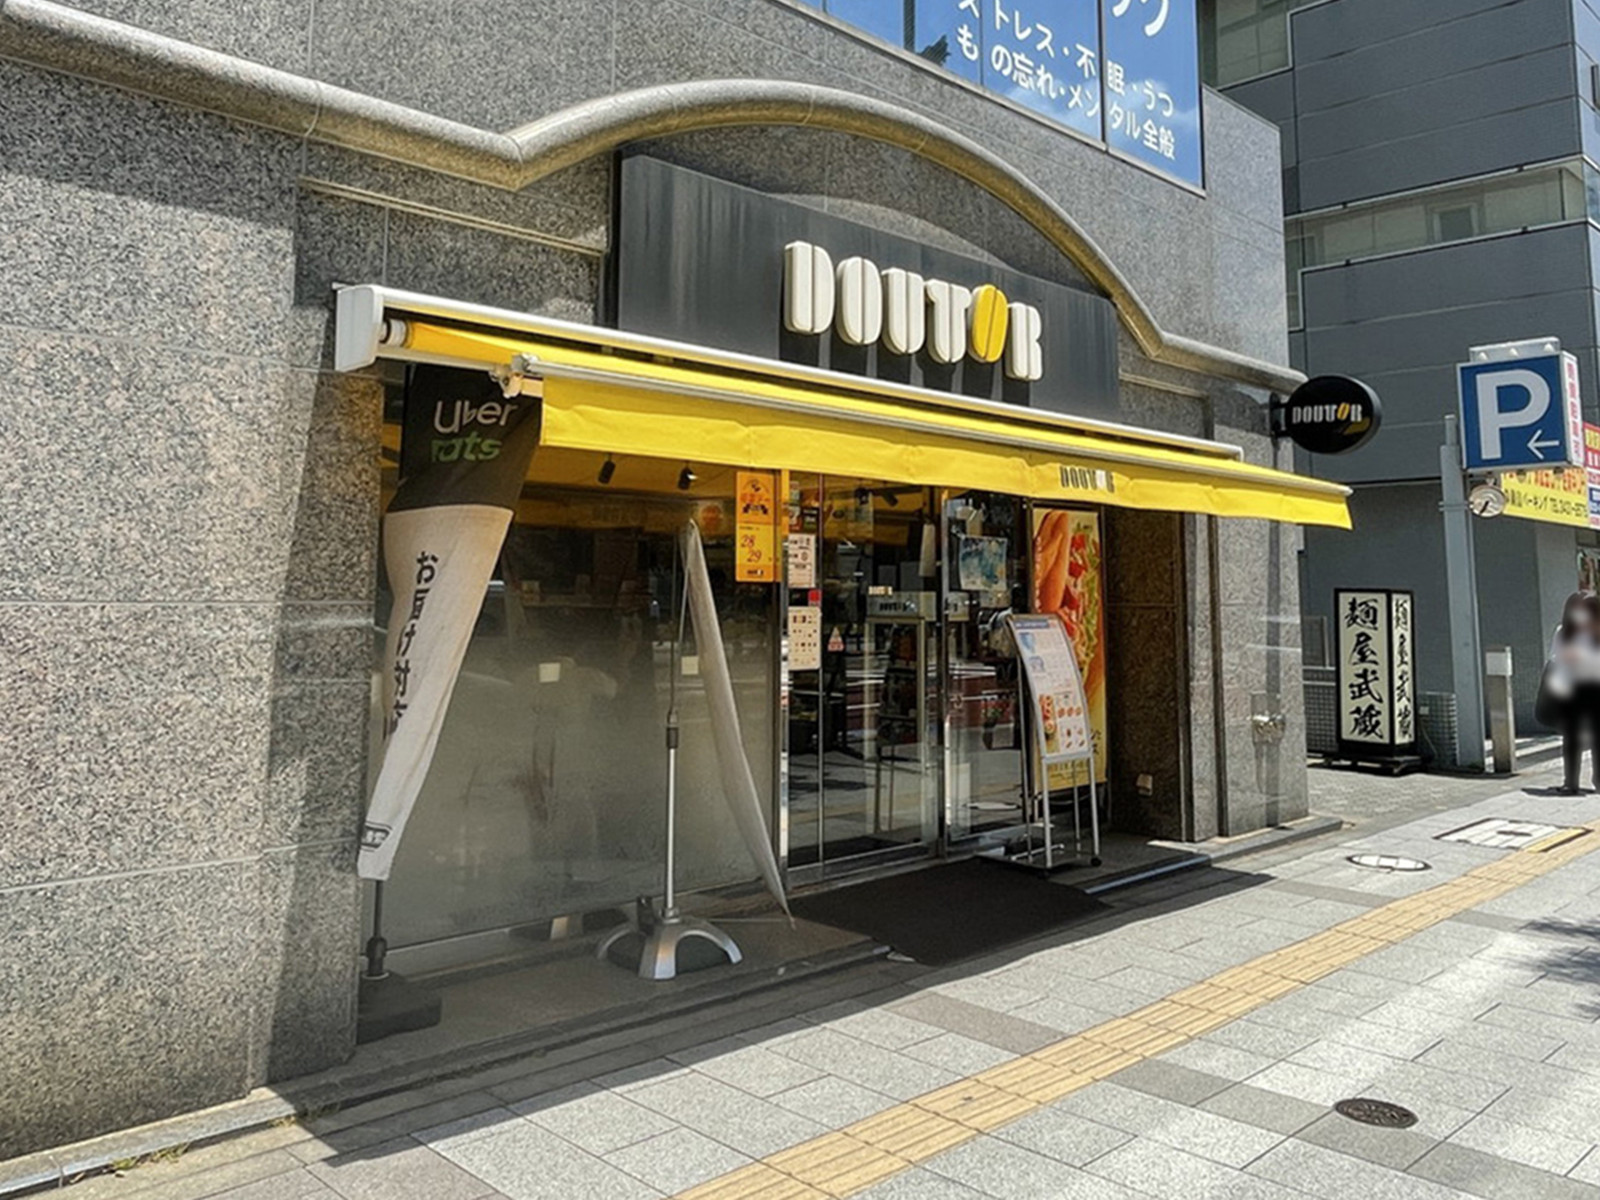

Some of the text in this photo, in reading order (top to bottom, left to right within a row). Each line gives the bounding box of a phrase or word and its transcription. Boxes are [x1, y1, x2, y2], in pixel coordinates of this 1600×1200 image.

[957, 24, 1175, 160] もの忘れ・メンタル全般
[785, 241, 1043, 381] DOUTOR
[434, 400, 518, 433] Uber
[1292, 402, 1362, 424] DOUTOR
[1476, 369, 1550, 460] P
[1345, 597, 1383, 740] 麺屋武蔵
